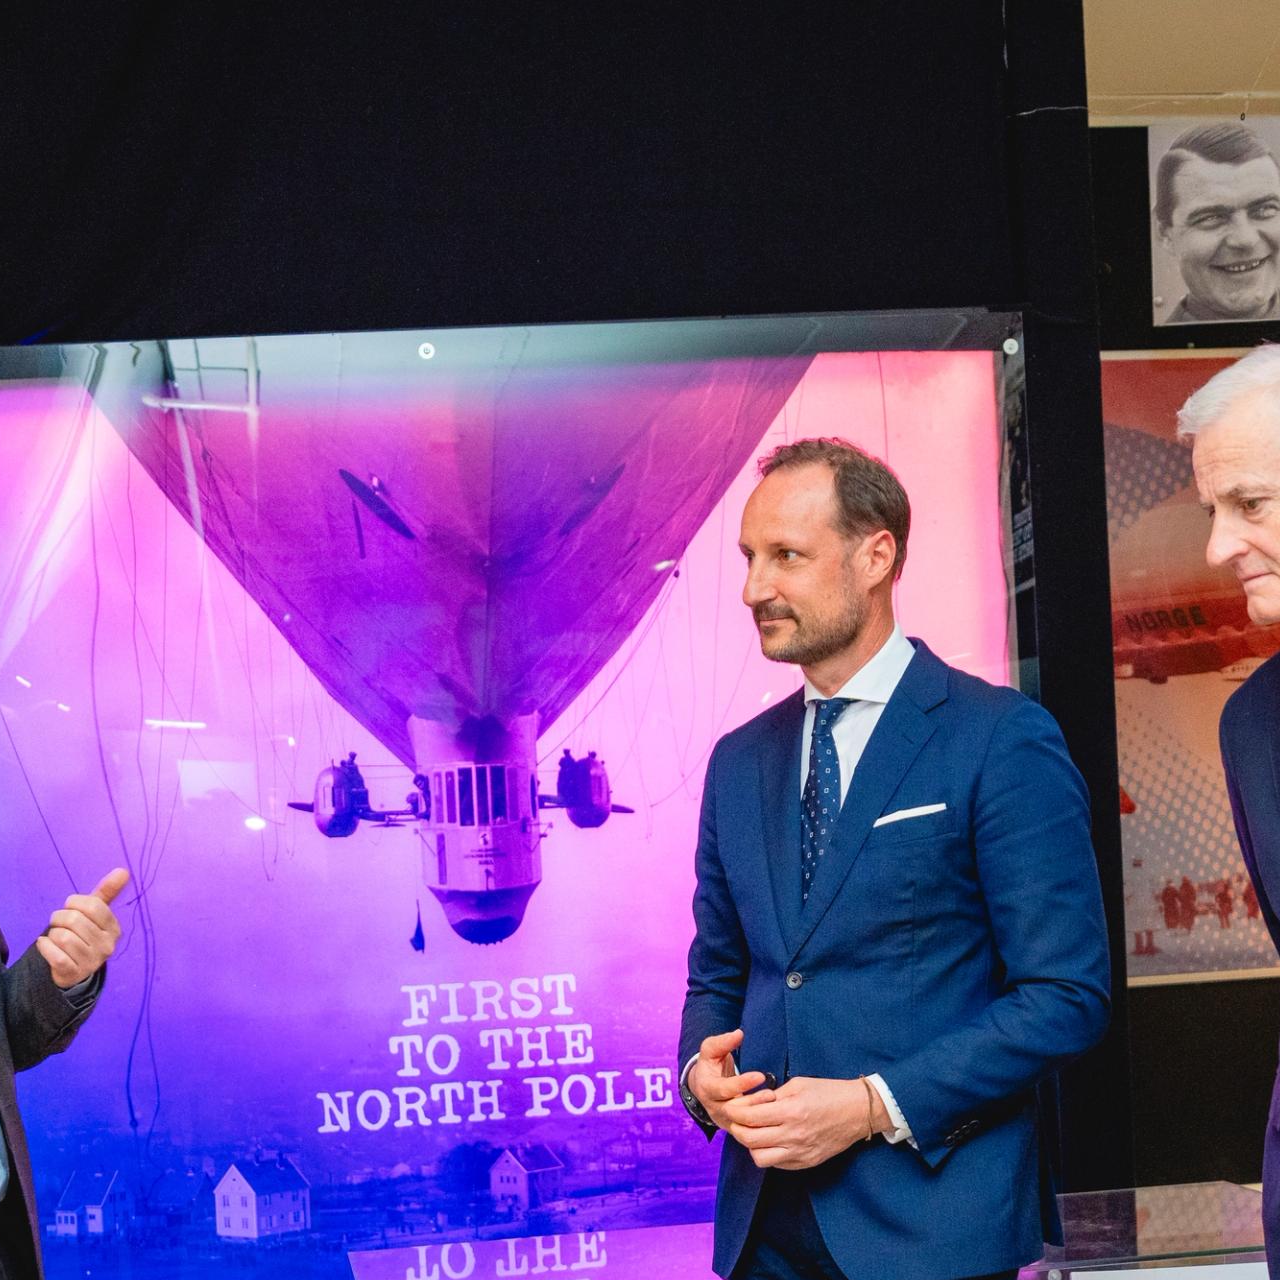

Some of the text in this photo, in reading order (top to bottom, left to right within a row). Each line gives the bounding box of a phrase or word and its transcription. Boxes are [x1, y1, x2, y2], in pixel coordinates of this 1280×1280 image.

[1125, 605, 1206, 633] NORGE
[400, 973, 577, 1027] FIRST
[388, 1023, 595, 1078] TO THE
[316, 1067, 673, 1134] NORTH POLE
